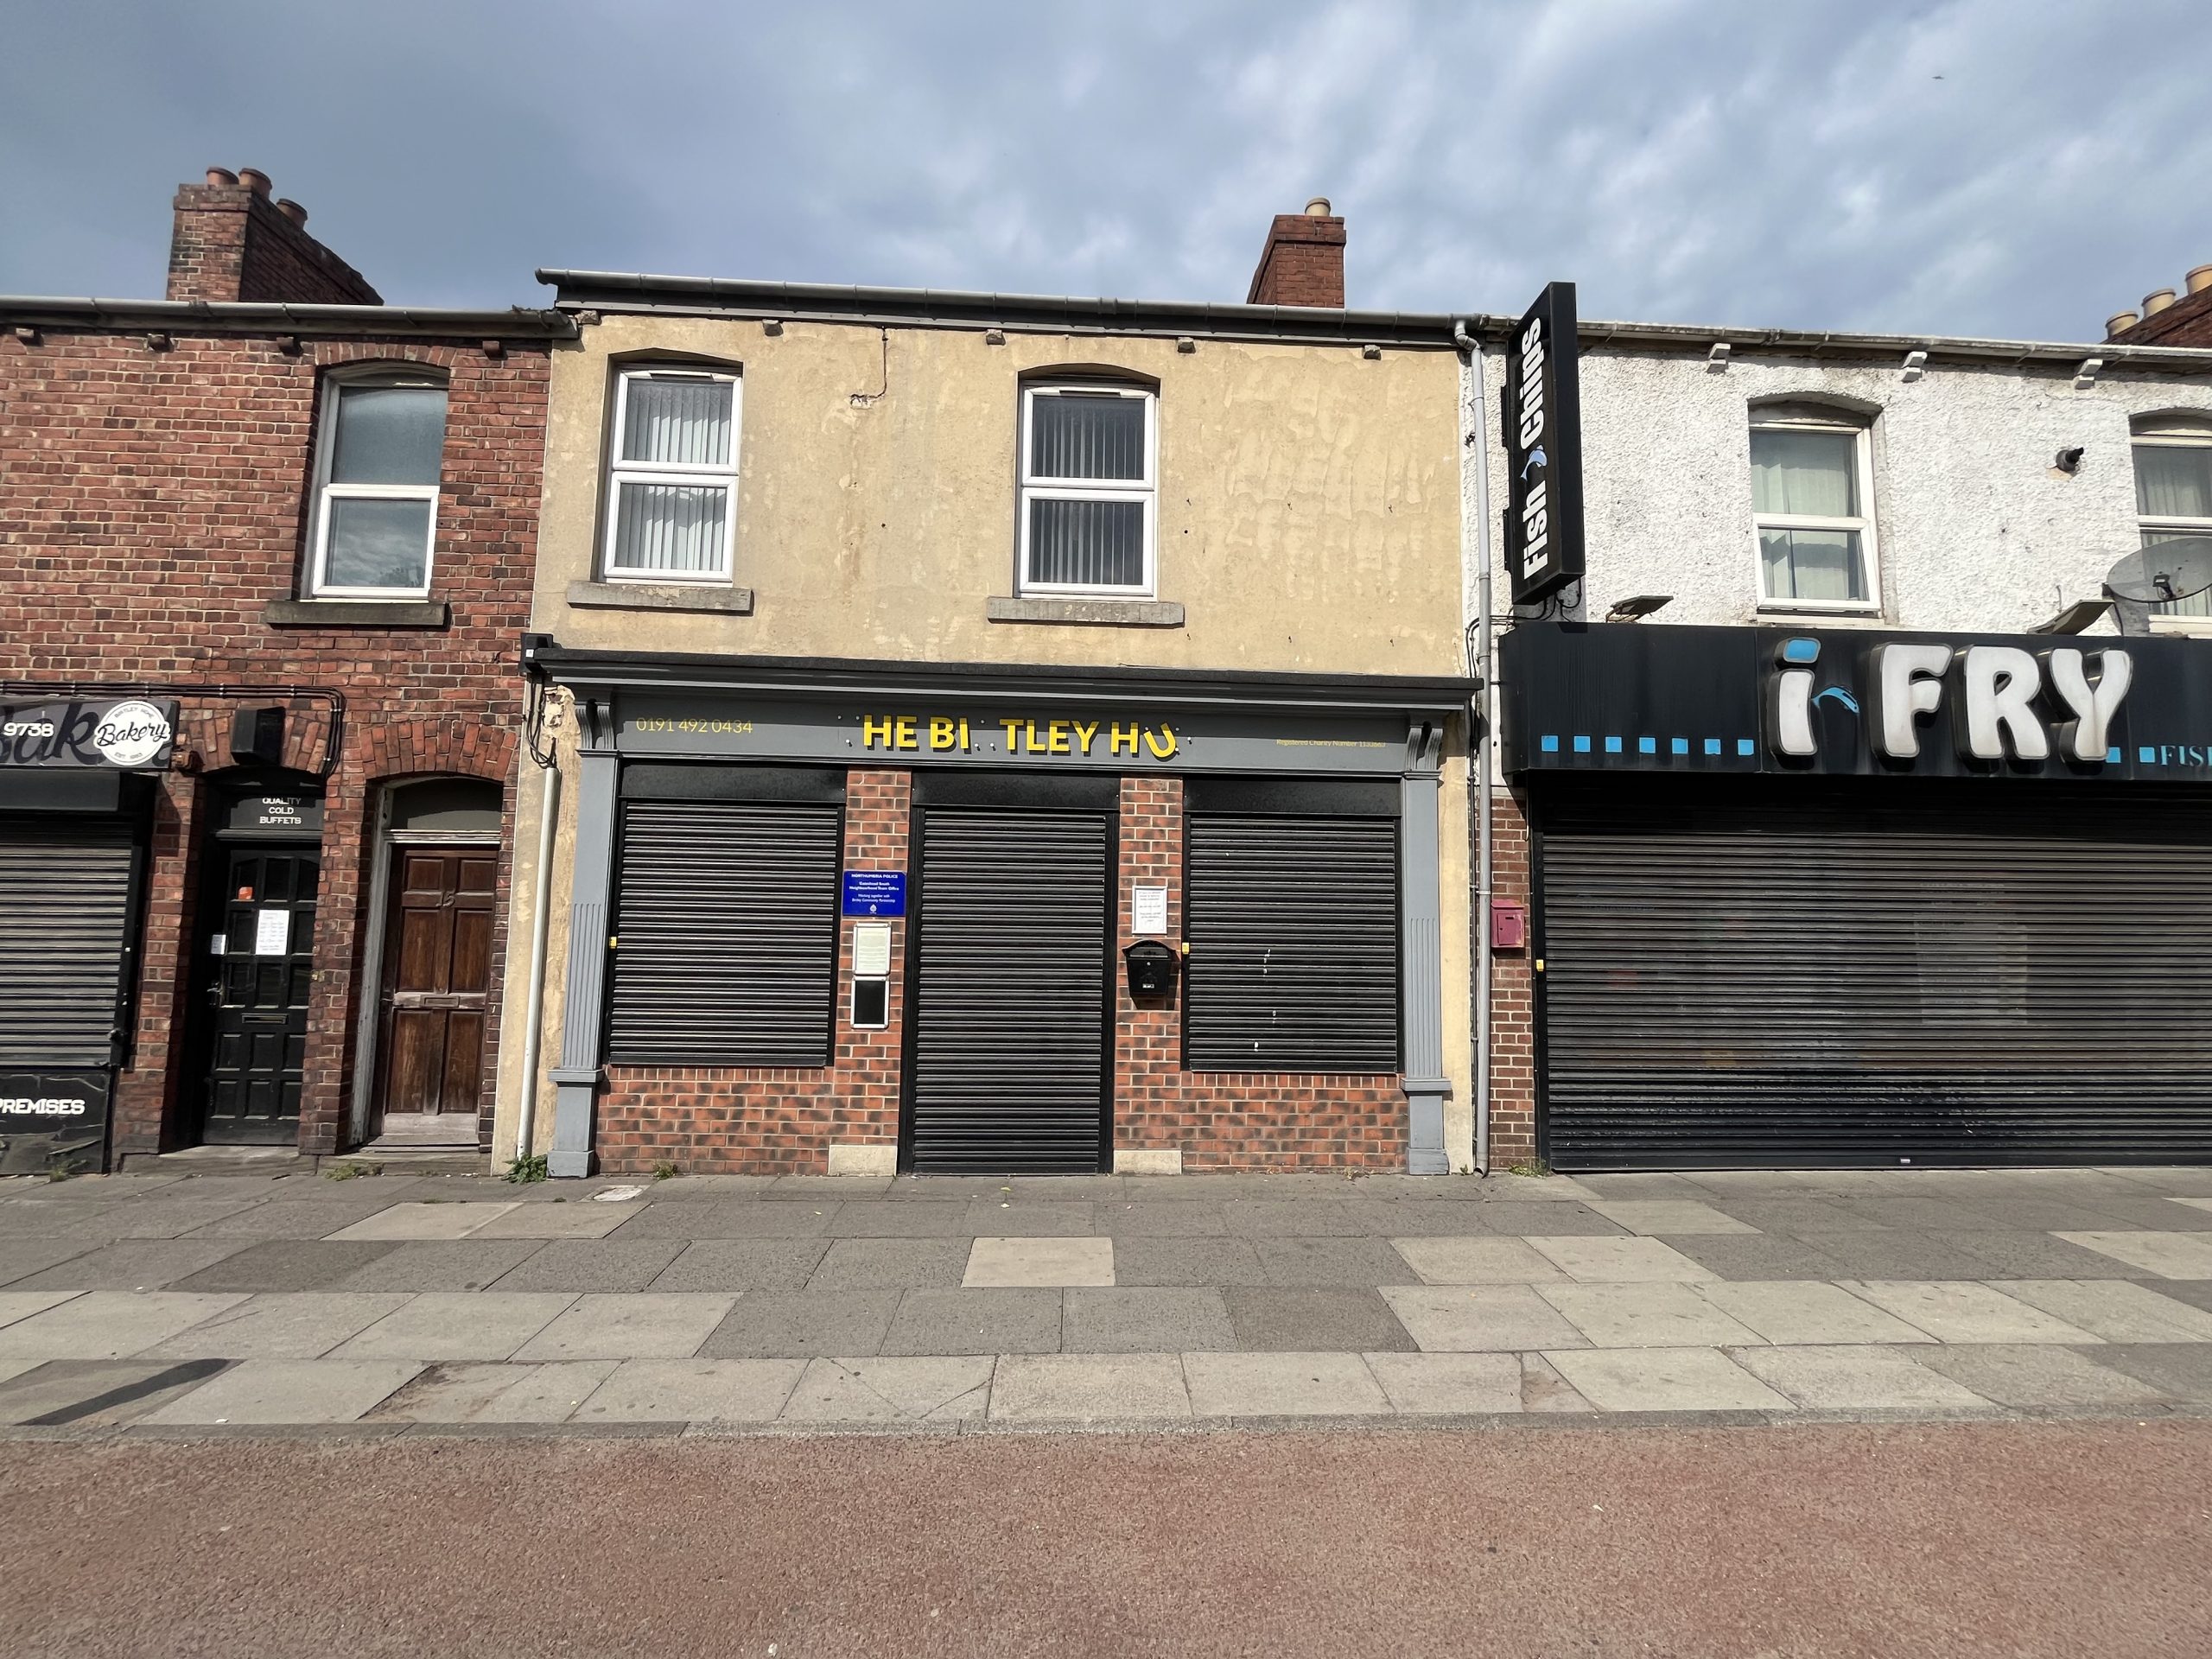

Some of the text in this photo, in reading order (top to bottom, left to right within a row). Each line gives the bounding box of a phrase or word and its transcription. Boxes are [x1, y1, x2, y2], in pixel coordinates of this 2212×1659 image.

[1520, 317, 1548, 580] Fish Chips
[1870, 641, 2133, 763] FRY
[3, 721, 54, 737] 9738
[97, 721, 168, 747] Bakery
[636, 717, 753, 734] 0191 492 0434
[2160, 745, 2212, 766] FIS
[0, 1098, 86, 1114] REMISES
